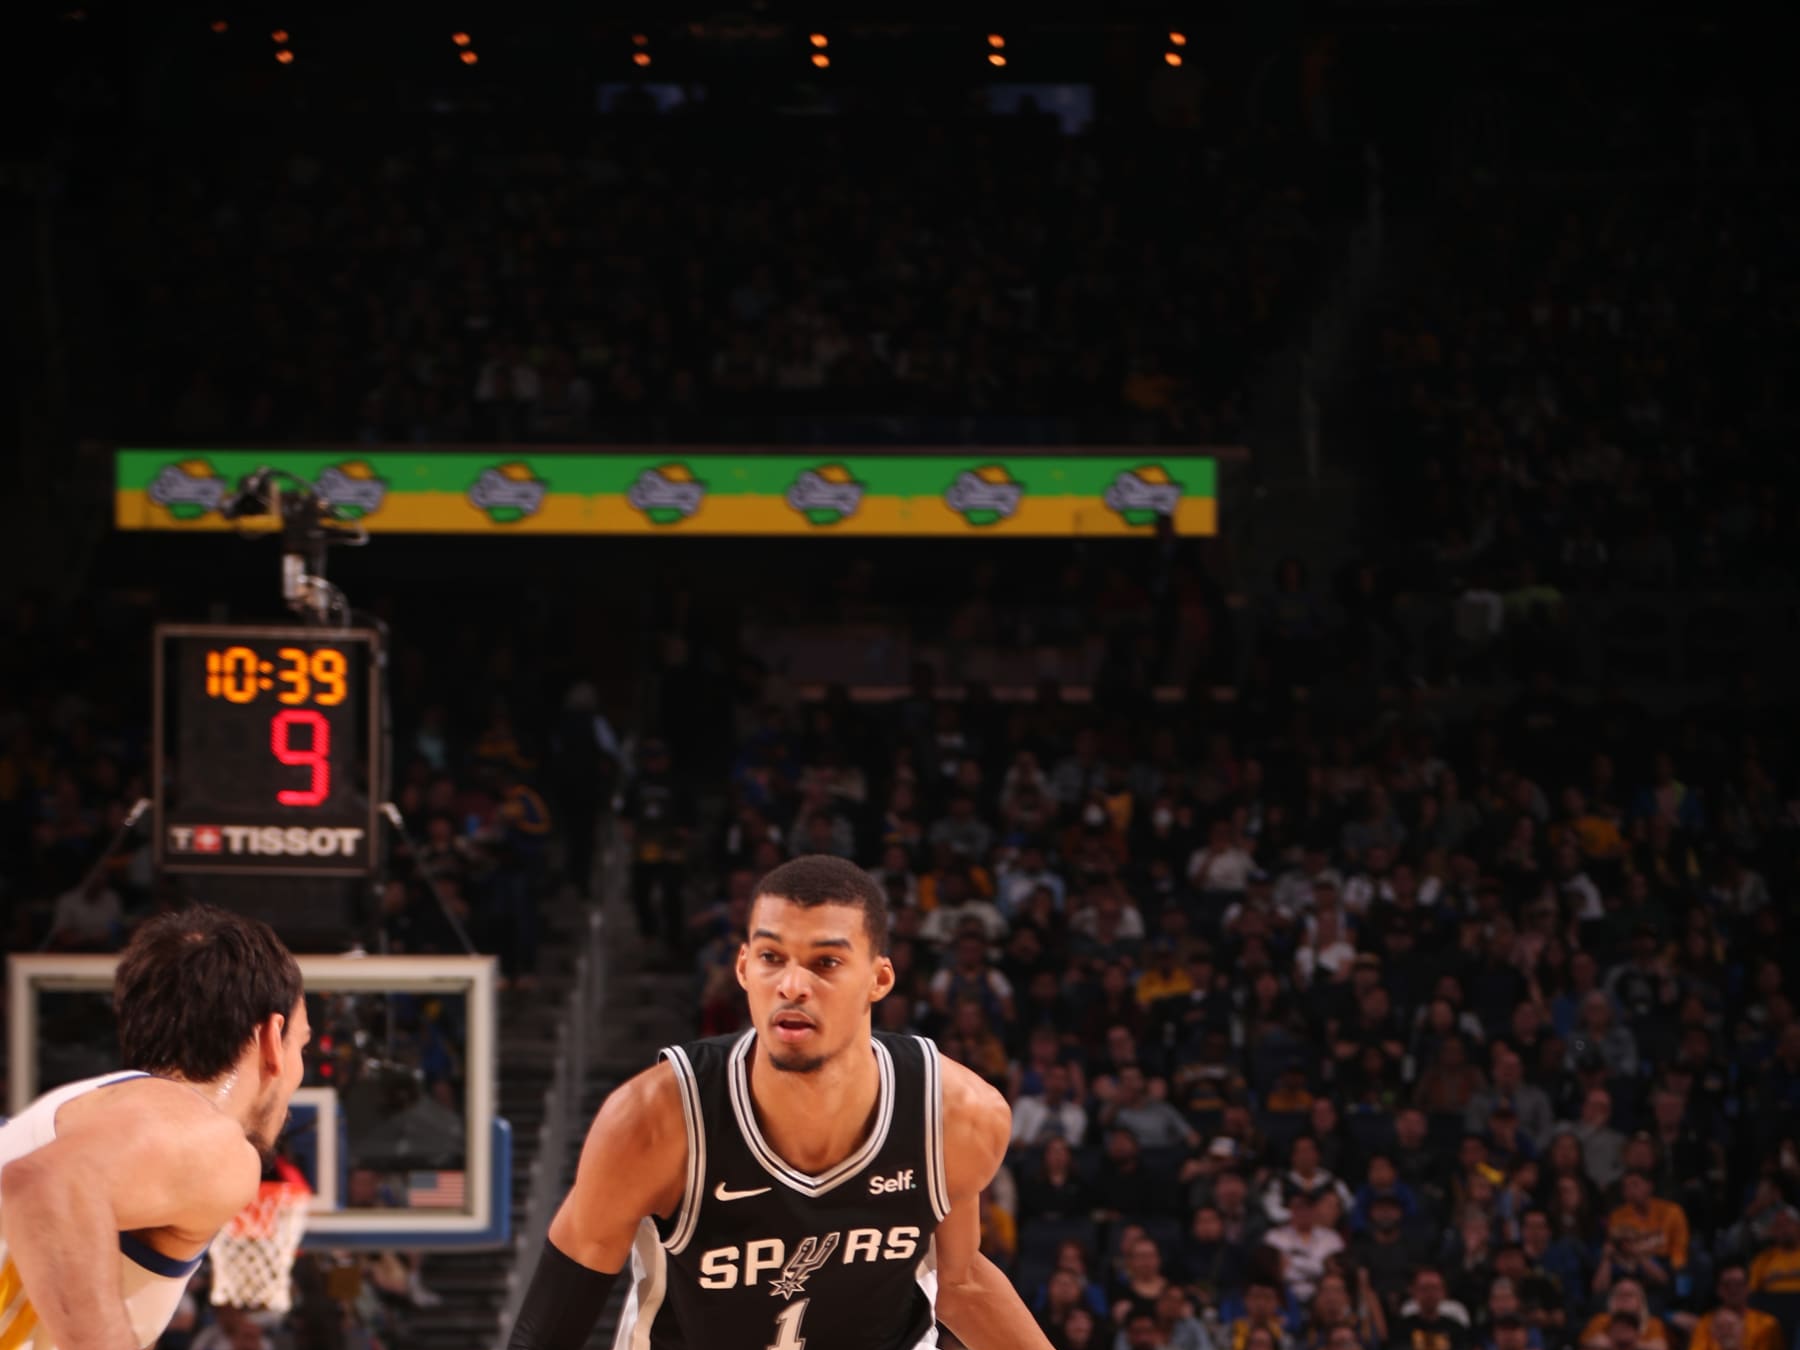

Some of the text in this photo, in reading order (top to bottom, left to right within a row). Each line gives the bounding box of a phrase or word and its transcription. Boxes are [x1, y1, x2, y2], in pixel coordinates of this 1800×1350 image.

[206, 645, 348, 706] 10:39
[271, 708, 331, 807] 9
[225, 828, 364, 856] TISSOT
